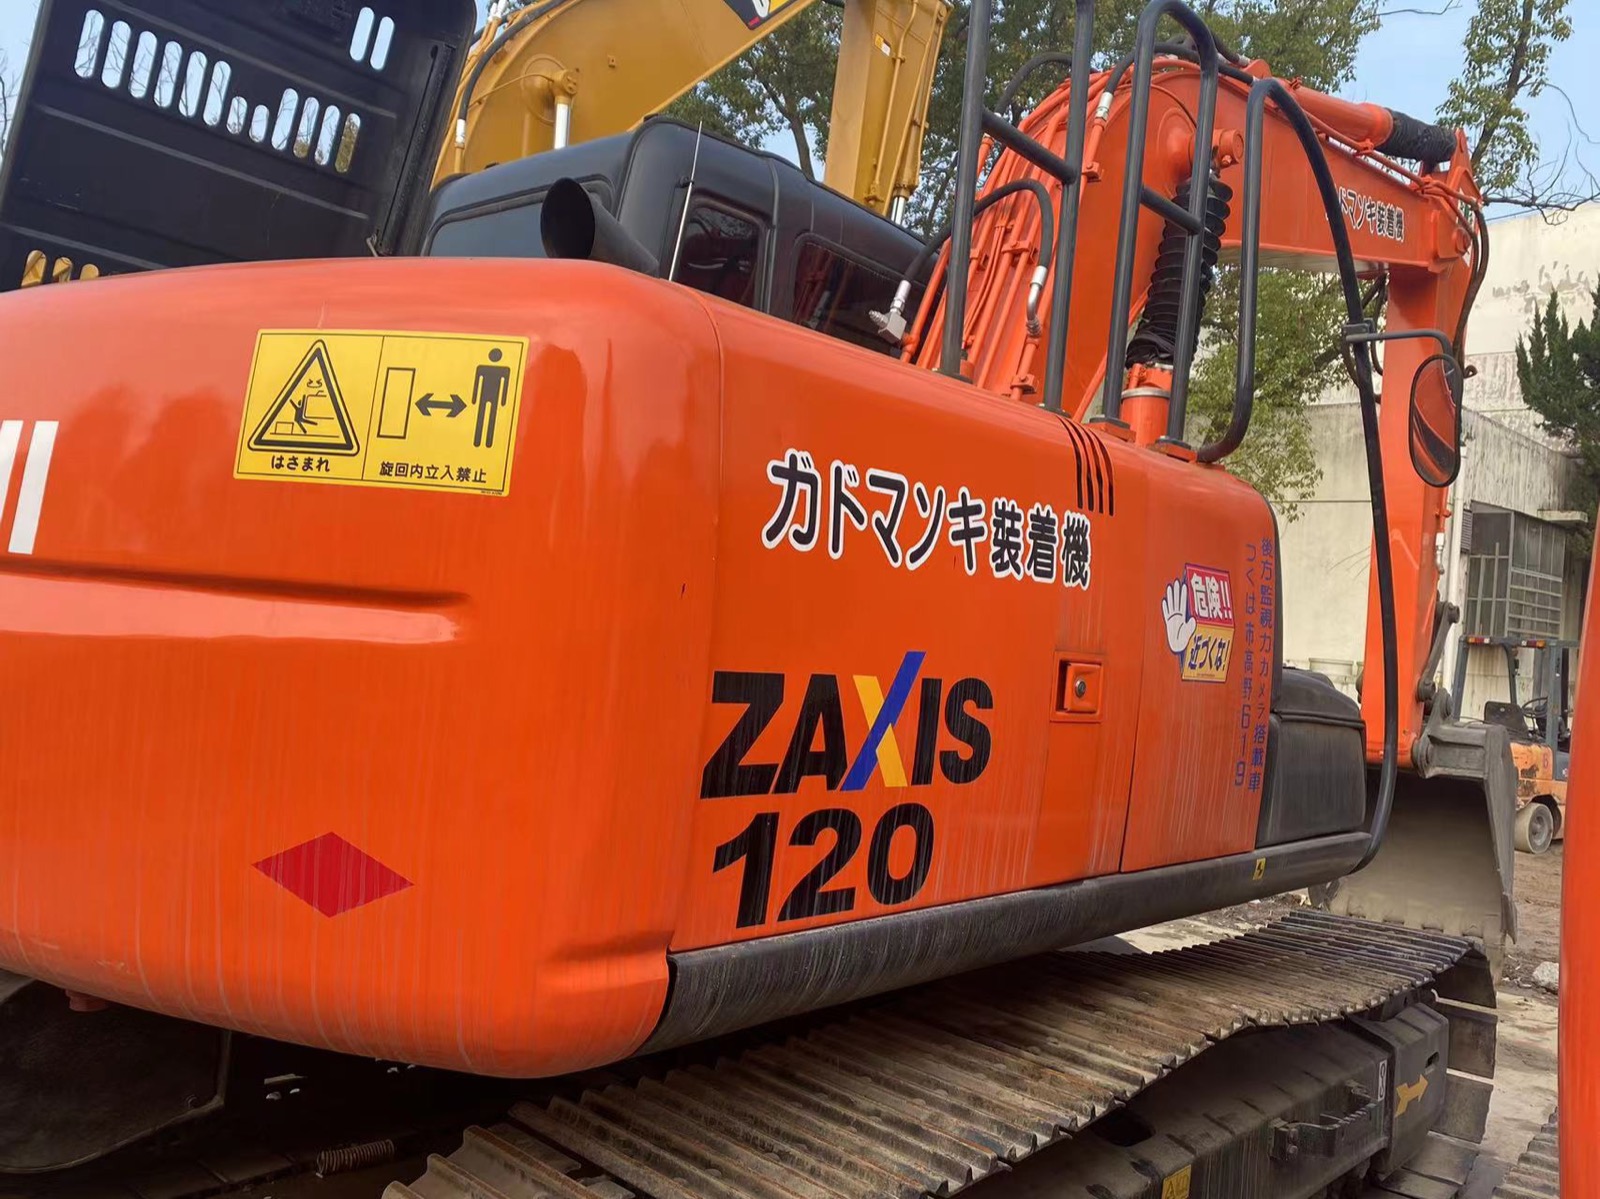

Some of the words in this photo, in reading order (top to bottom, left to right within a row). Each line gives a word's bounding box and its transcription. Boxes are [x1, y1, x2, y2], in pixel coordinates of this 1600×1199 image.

[271, 455, 330, 472] はさまれ
[379, 461, 486, 483] 旋回内立入禁止
[1191, 573, 1232, 619] 危険!!
[1188, 635, 1230, 671] 近づくな!
[700, 650, 993, 799] ZAXIS
[713, 803, 934, 929] 120
